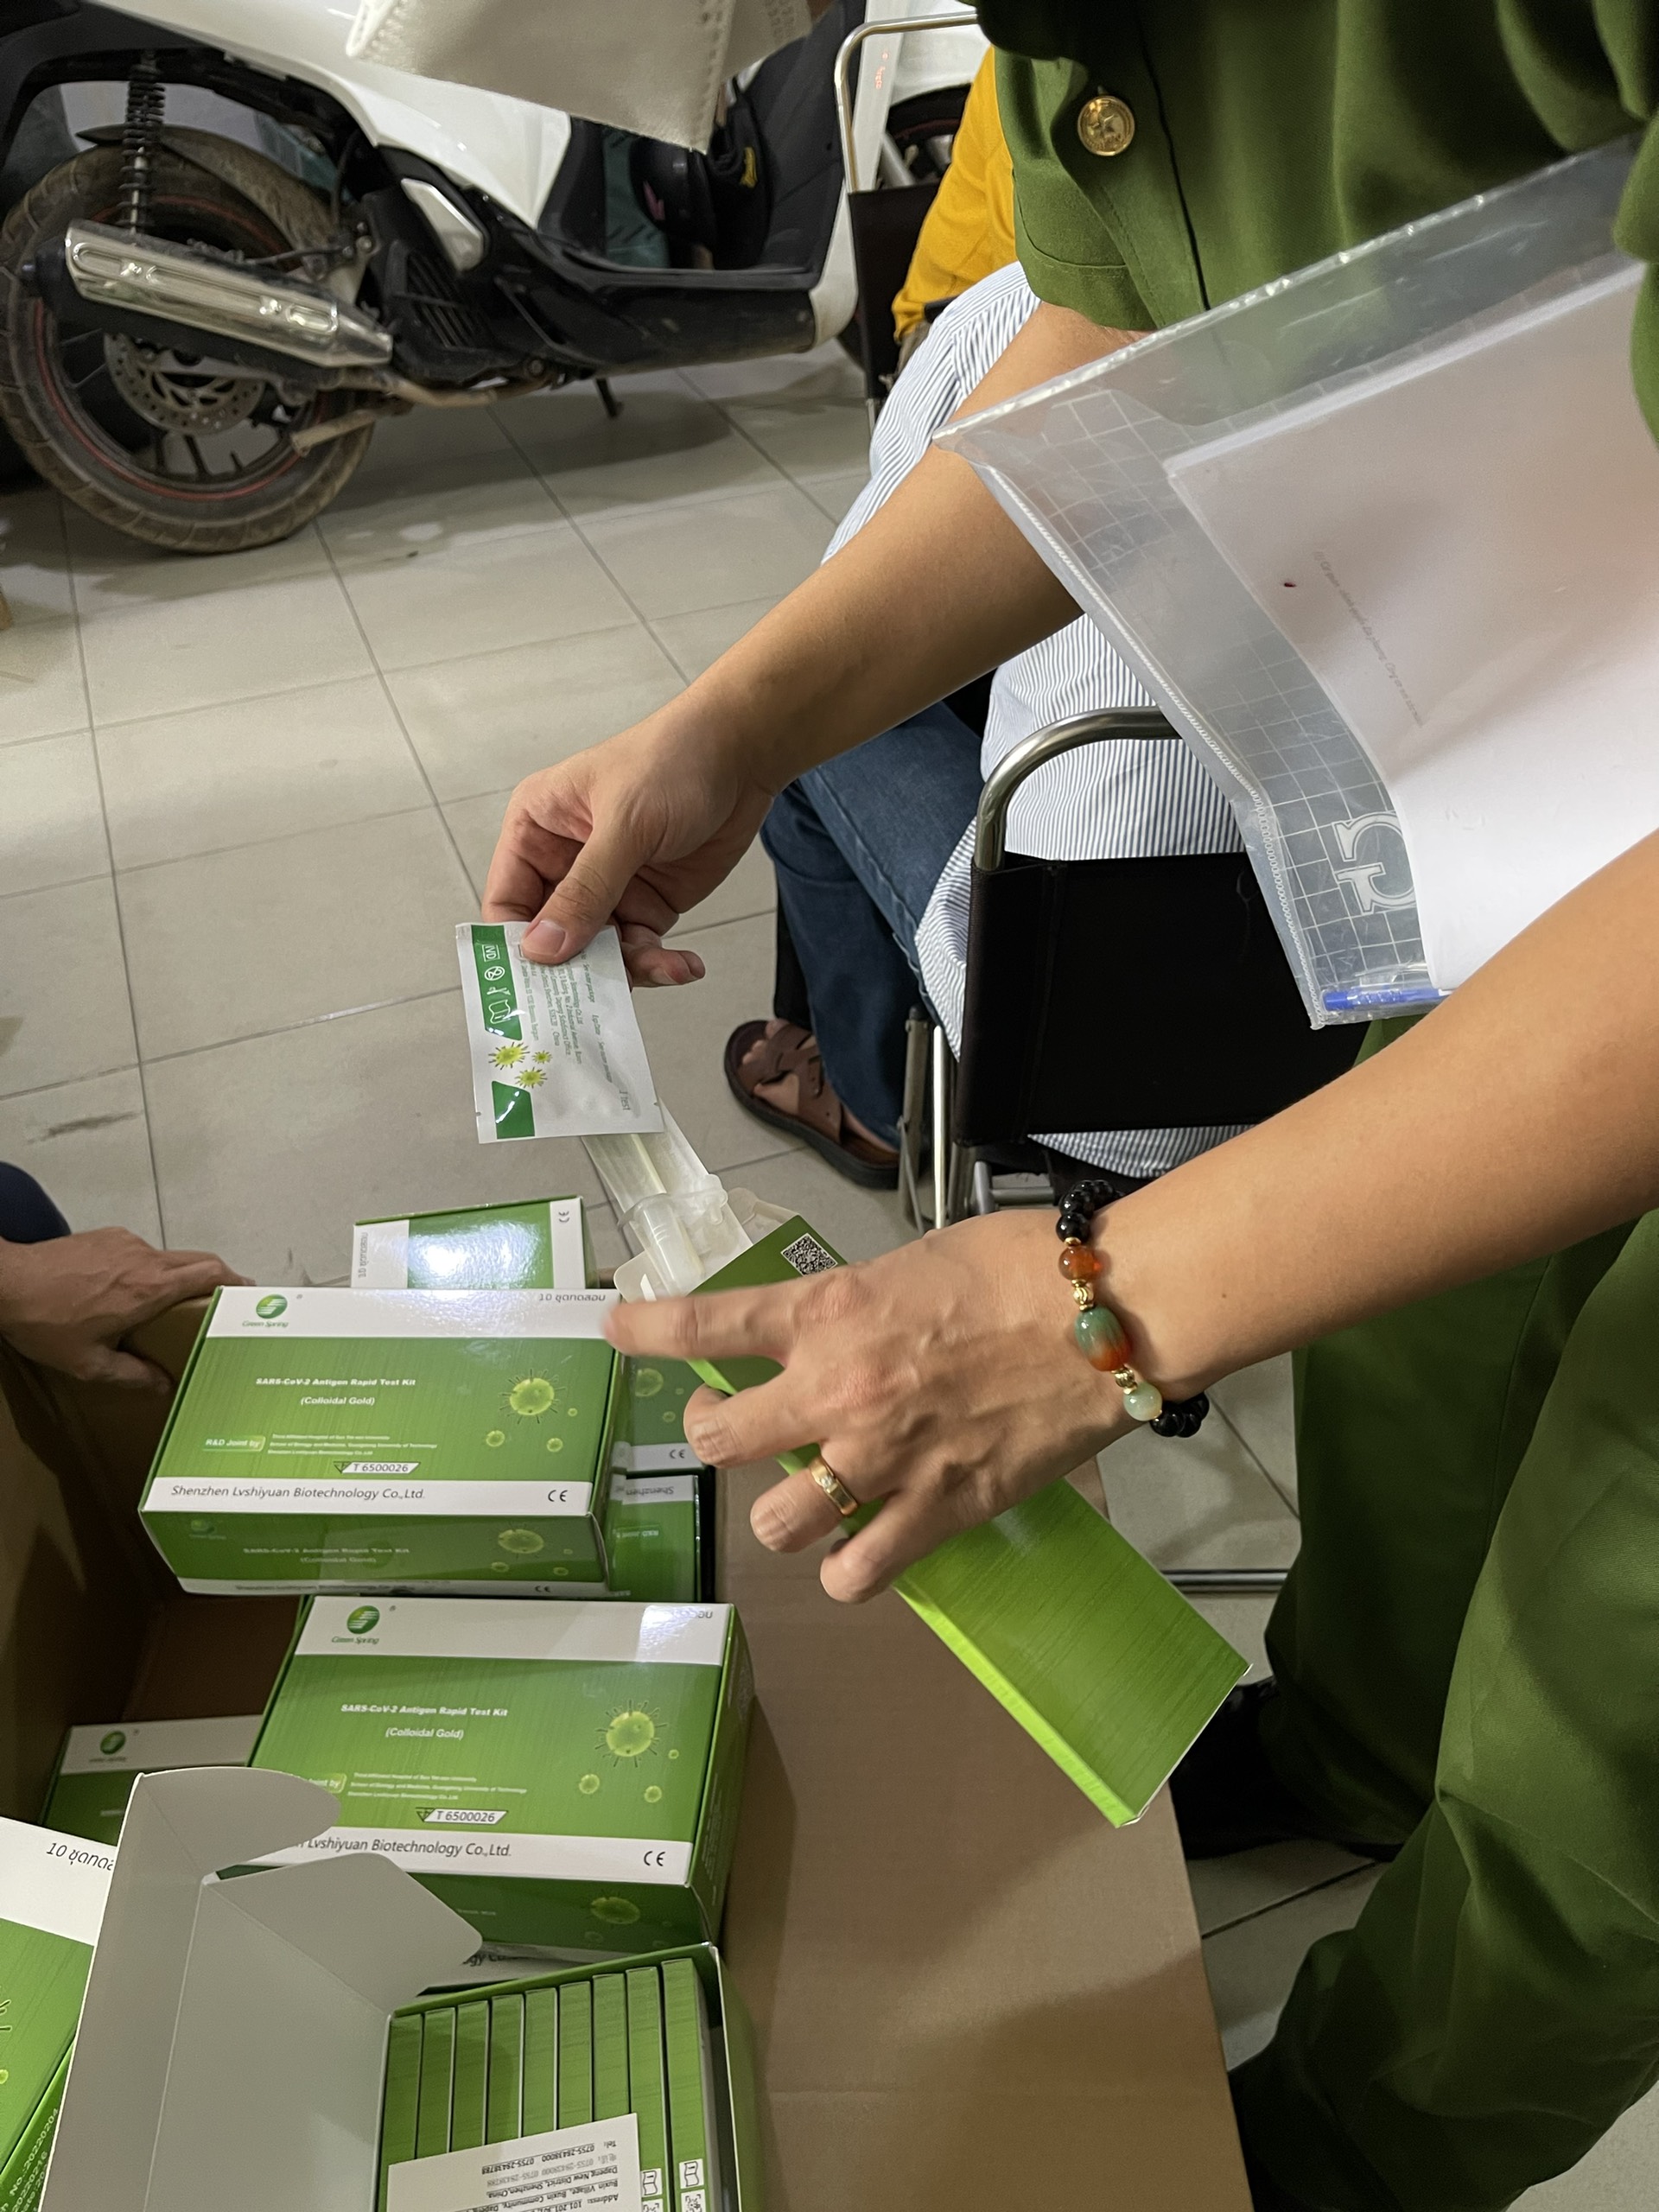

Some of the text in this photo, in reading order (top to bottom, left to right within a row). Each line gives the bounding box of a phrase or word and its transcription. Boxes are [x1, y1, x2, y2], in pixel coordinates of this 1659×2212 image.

[312, 1378, 348, 1387] Antigen
[351, 1378, 378, 1387] Rapid
[301, 1396, 375, 1406] (Colloidal Gold)
[205, 1438, 225, 1446] R&D
[249, 1440, 260, 1448] by
[361, 1463, 409, 1472] 6500026
[171, 1485, 230, 1497] Shenzhen
[232, 1488, 290, 1499] Lvshiyuan
[294, 1487, 379, 1501] Biotechnology
[340, 1704, 398, 1713] SARS-CoV-2
[399, 1706, 436, 1715] Antigen
[439, 1707, 467, 1716] Rapid
[385, 1727, 463, 1739] (Colloidal Gold)
[436, 1810, 495, 1822] T 6500026
[46, 1842, 67, 1857] 10
[308, 1837, 368, 1853] Lvshiyuan
[372, 1839, 462, 1857] Biotechnology
[591, 2164, 618, 2177] Dapeng
[547, 2176, 572, 2190] District,
[574, 2172, 589, 2182] New
[601, 2178, 619, 2189] Buxin
[547, 2189, 567, 2201] Buxin
